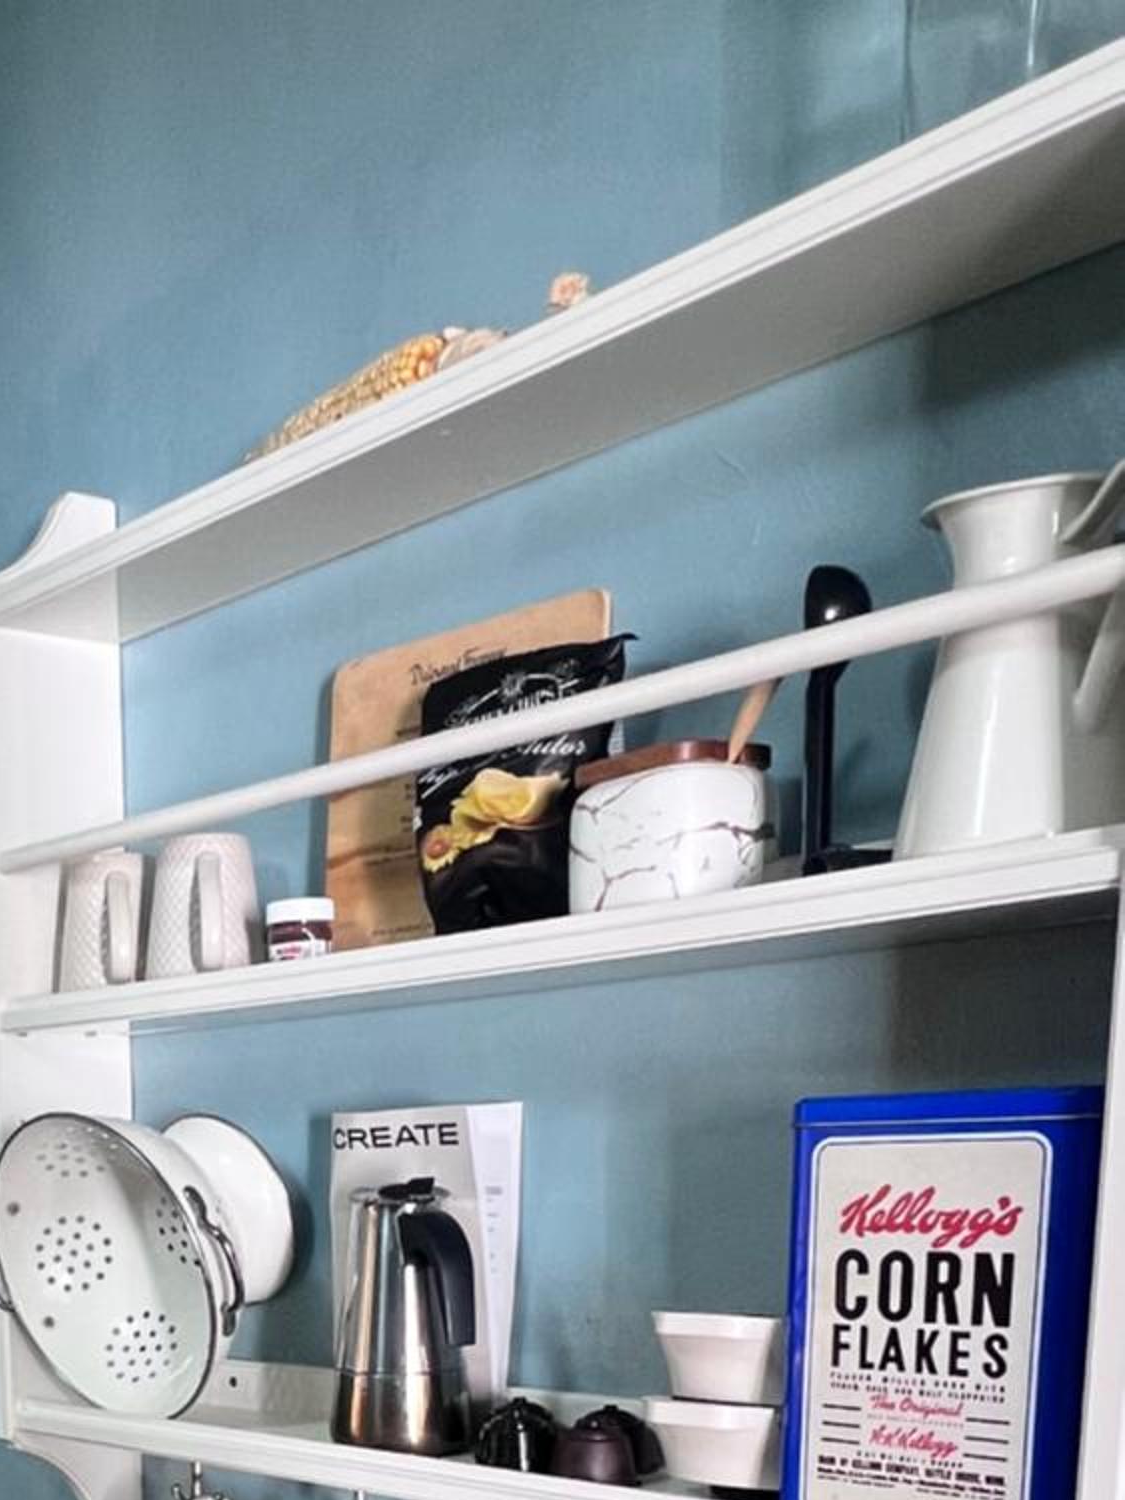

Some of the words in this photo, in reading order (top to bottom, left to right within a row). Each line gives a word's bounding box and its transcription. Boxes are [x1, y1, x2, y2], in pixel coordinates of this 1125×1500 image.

[332, 1122, 459, 1150] CREATE
[839, 1184, 1024, 1249] Kellogg's
[835, 1248, 1015, 1328] CORN
[831, 1323, 1009, 1379] FLAKES
